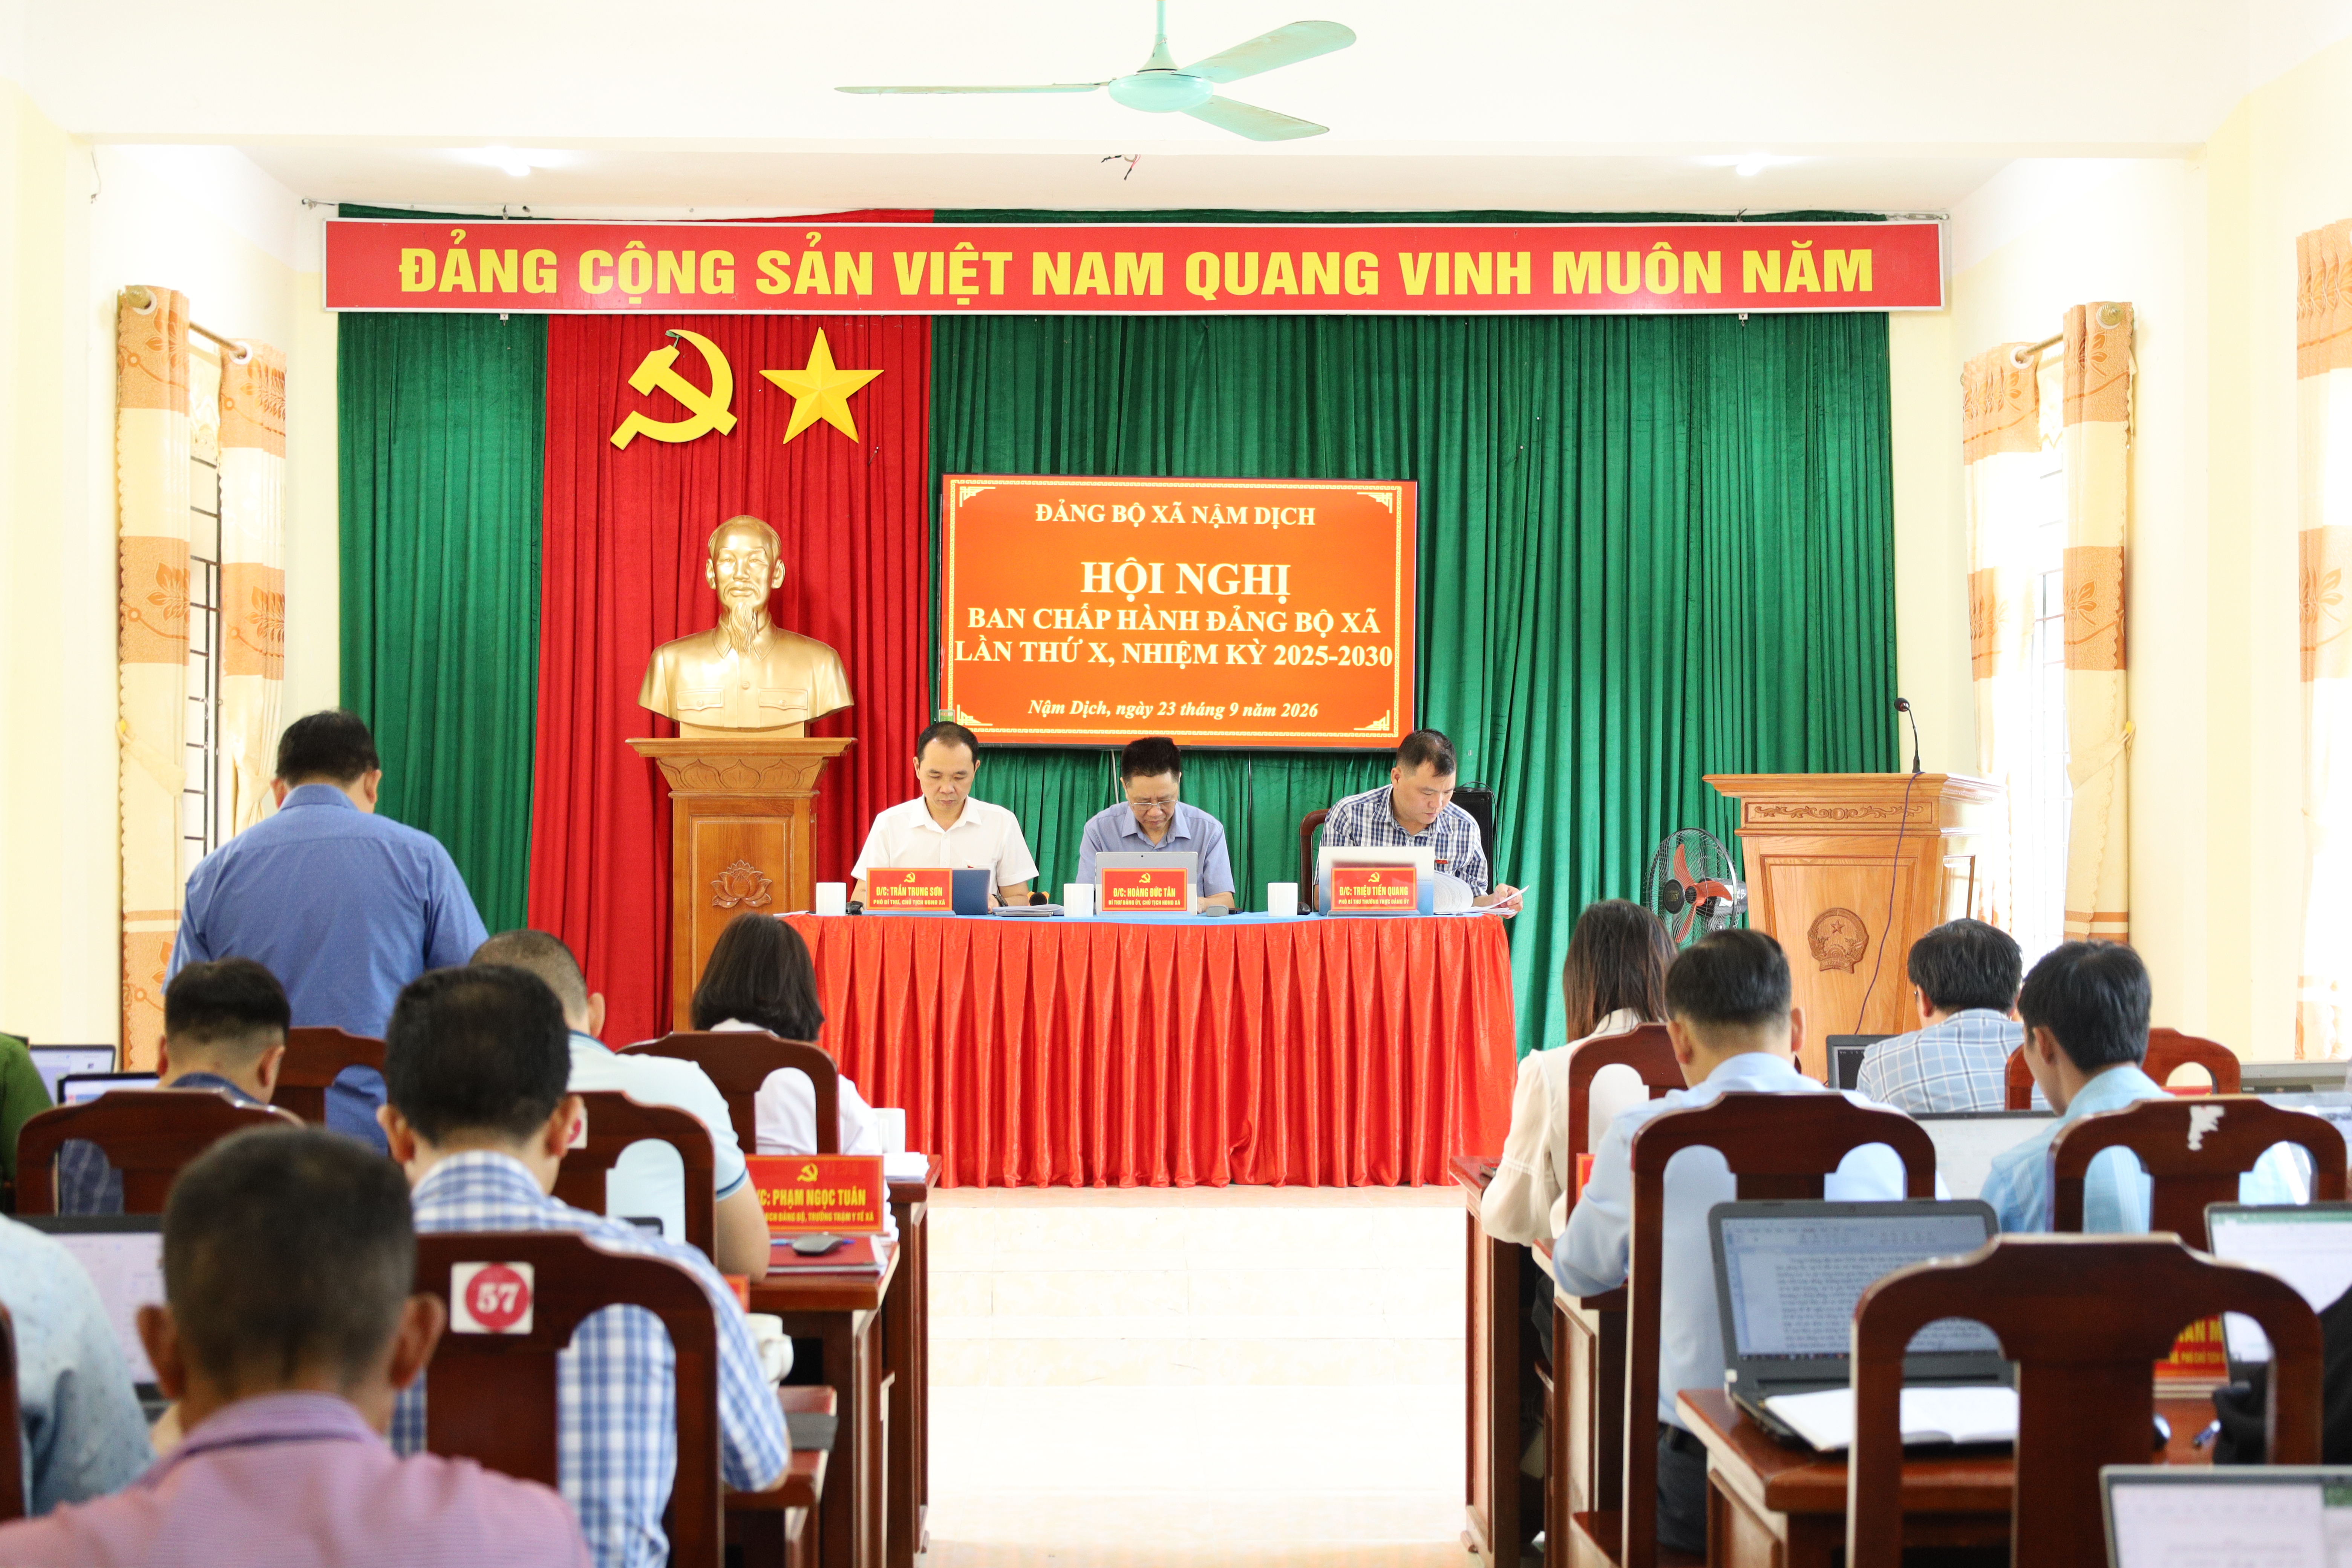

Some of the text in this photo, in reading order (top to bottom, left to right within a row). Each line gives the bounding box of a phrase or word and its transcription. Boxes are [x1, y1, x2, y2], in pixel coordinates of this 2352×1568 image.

[399, 229, 1873, 305] ĐẢNG CỘNG SẢN VIỆT NAM QUANG VINH MUÔN NĂM
[1035, 499, 1316, 530] ĐẢNG BỘ XÃ NẬM DỊCH
[1080, 557, 1291, 604] HỘI NGHỊ
[967, 603, 1381, 638] BAN CHẤP HÀNH ĐẢNG BỘ XÃ
[954, 635, 1393, 670] LẦN THỨ X, NHIỆM KỲ 2025-2030
[1027, 700, 1318, 720] Nậm Dịch, ngày 23 tháng 9 năm 2026
[876, 884, 943, 896] Đ/C: TRẦN TRUNG SƠN
[1113, 886, 1176, 897] Đ/C: HOÀNG ĐỨC TÂN
[1339, 884, 1409, 897] Đ/C: TRIỆU TIẾN QUANG
[772, 1189, 804, 1209] PHẠM
[806, 1189, 836, 1209] NGỌC
